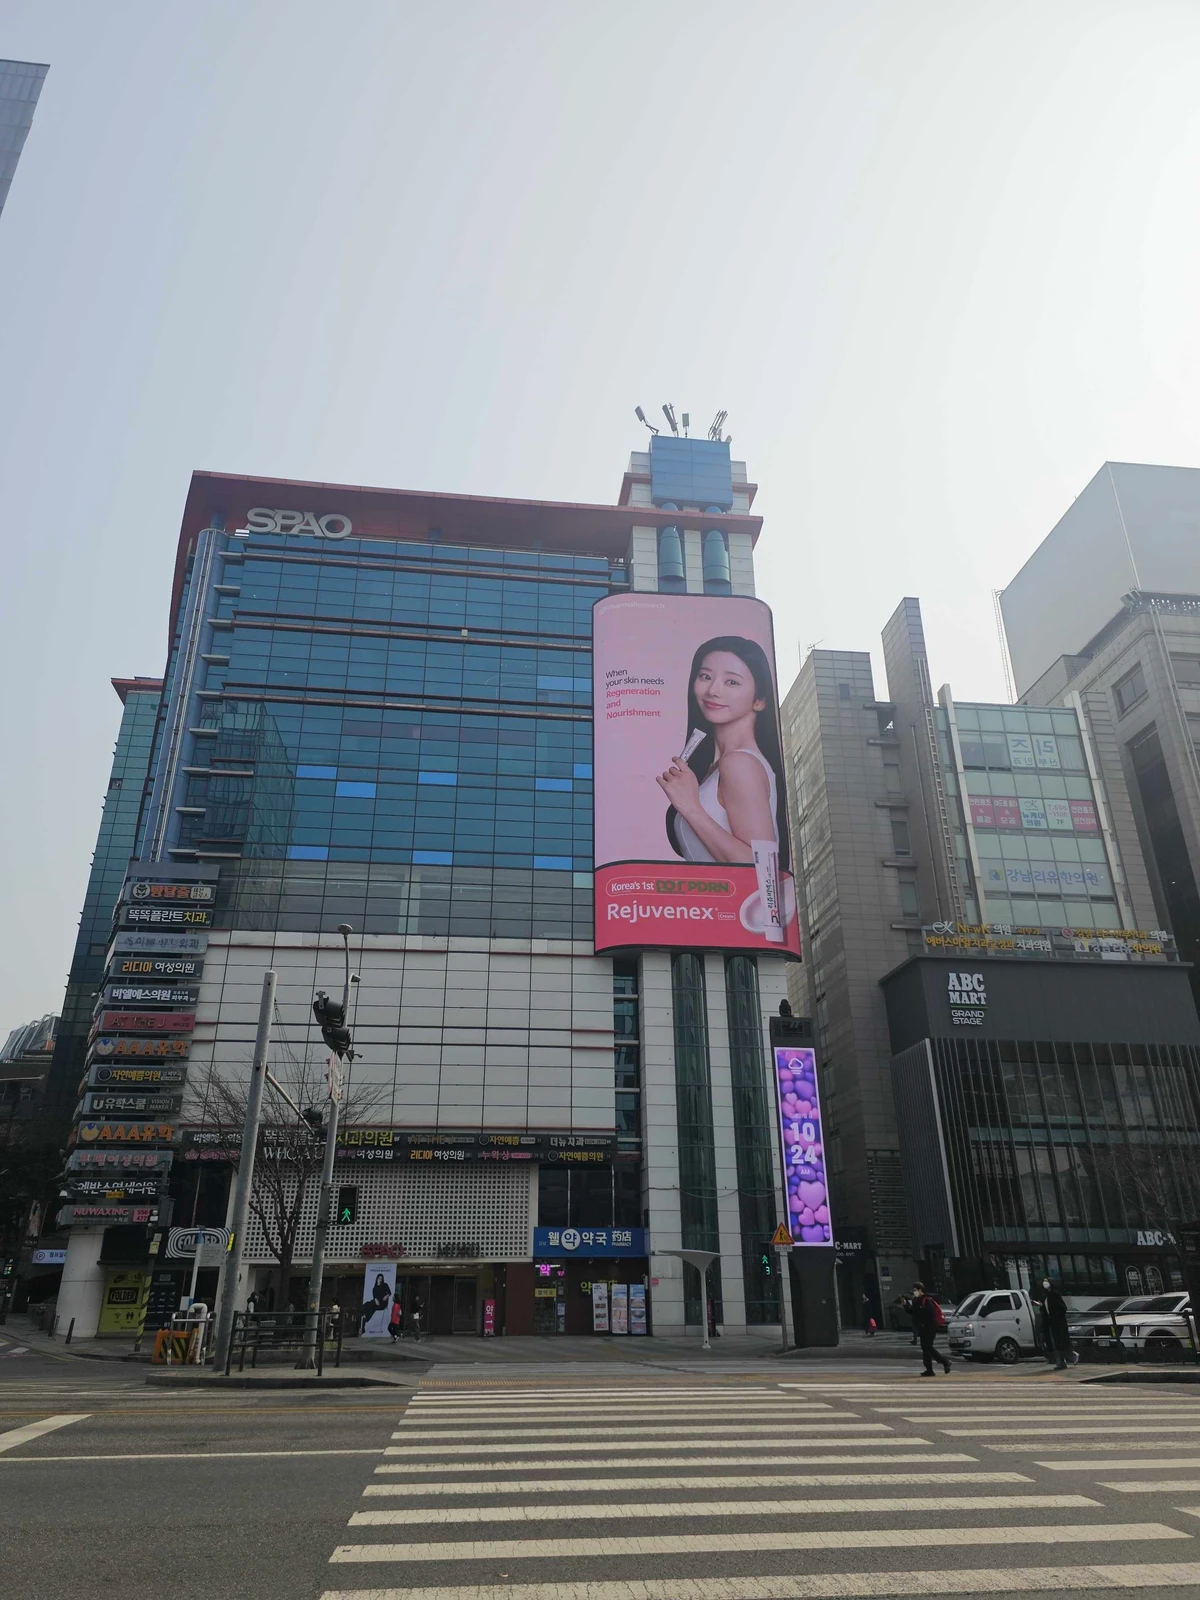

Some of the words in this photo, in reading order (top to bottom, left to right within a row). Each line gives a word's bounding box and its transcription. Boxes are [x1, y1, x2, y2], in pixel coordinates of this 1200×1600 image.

[245, 507, 353, 539] SPAO
[605, 669, 628, 679] When
[605, 678, 624, 690] your
[624, 677, 639, 685] skin
[606, 688, 661, 698] Regeneration
[606, 699, 621, 709] and
[606, 709, 661, 719] Nourishment
[611, 879, 641, 892] Korea's
[641, 880, 655, 891] 1st
[607, 901, 714, 923] Rejuvenex
[993, 924, 1012, 936] 의원
[1150, 929, 1168, 942] 의원
[1016, 939, 1052, 952] 치과의원
[122, 960, 153, 973] 리디아
[155, 961, 195, 974] 여성의원
[947, 972, 985, 992] ABC
[112, 988, 171, 1001] 비엘에스의원
[948, 991, 987, 1005] MART
[951, 1010, 984, 1018] GRAND
[952, 1017, 983, 1025] STAGE
[112, 1039, 188, 1057] AAA유학
[104, 1098, 147, 1110] 유학스쿨
[98, 1124, 175, 1142] AAA유학
[789, 1122, 816, 1143] 10
[550, 1137, 585, 1147] 더뉴치과
[410, 1149, 433, 1160] 리디아
[434, 1149, 465, 1160] 여성의원
[790, 1144, 818, 1165] 24
[801, 1167, 811, 1176] AM
[73, 1208, 129, 1217] NUWAXING
[178, 1236, 219, 1250] FOLER
[581, 1231, 608, 1246] 약국
[360, 1243, 405, 1258] SPAO
[835, 1241, 863, 1250] C-MART
[540, 1264, 551, 1276] 약
[765, 1266, 771, 1275] 3
[110, 1289, 137, 1302] FOLDER
